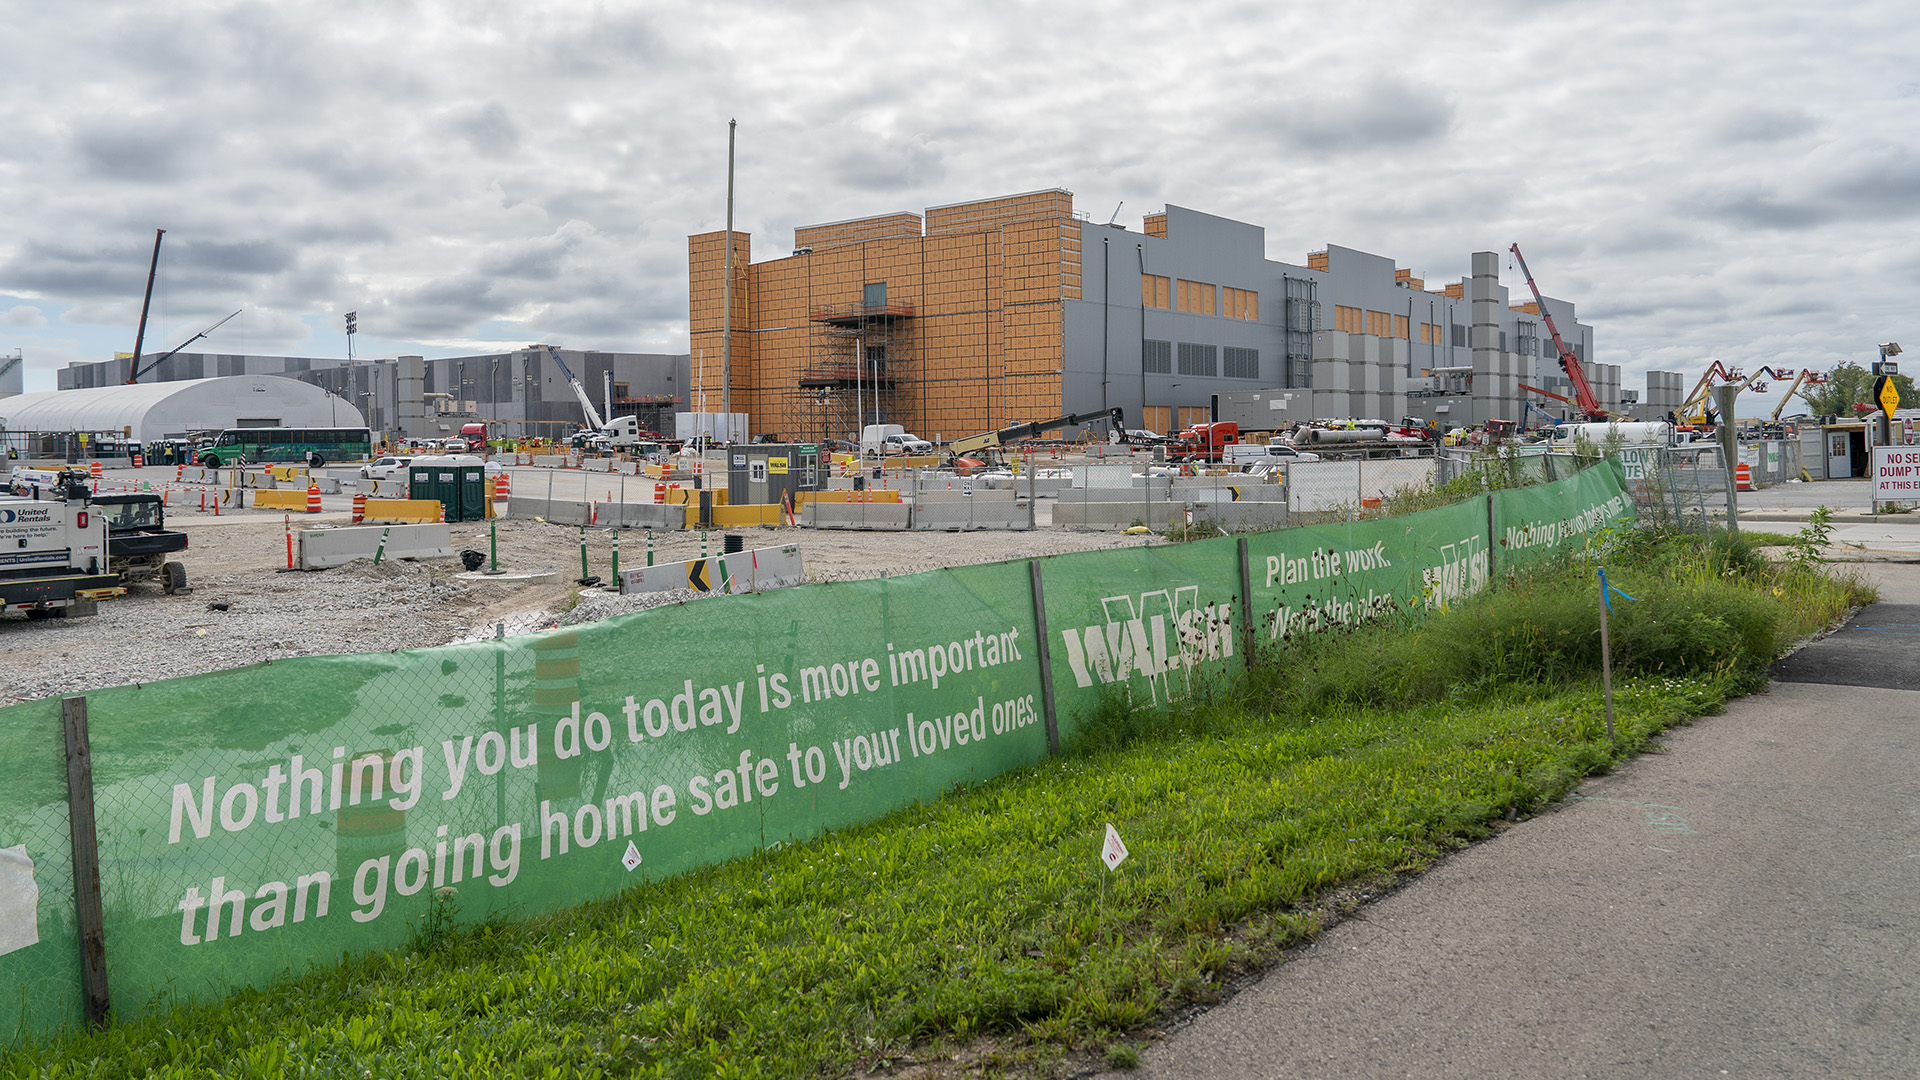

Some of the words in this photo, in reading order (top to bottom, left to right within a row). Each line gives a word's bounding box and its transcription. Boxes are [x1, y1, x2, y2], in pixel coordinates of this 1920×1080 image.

[1880, 466, 1912, 477] DUMP
[1887, 453, 1902, 464] NO
[1905, 453, 1920, 464] SE
[1880, 481, 1890, 490] AT
[1892, 481, 1912, 490] THIS
[1913, 481, 1920, 489] E
[17, 508, 48, 516] United
[17, 515, 51, 523] Rentals
[1505, 520, 1556, 550] Nothing
[1266, 552, 1308, 588] Plan
[1311, 547, 1341, 580] the
[1345, 540, 1392, 574] work.
[1325, 596, 1353, 628] the
[1062, 586, 1233, 705] WALSH
[168, 745, 424, 845] Nothing
[441, 723, 538, 800] you
[553, 701, 612, 761] do
[622, 679, 745, 735] today
[757, 664, 792, 713] is
[800, 657, 880, 704] more
[887, 626, 1022, 690] important
[178, 869, 332, 946] than
[350, 822, 522, 923] going
[540, 784, 677, 861] home
[688, 749, 779, 816] safe
[786, 742, 826, 789] to
[832, 727, 901, 790] your
[906, 693, 986, 757] loved
[992, 692, 1038, 737] ones.
